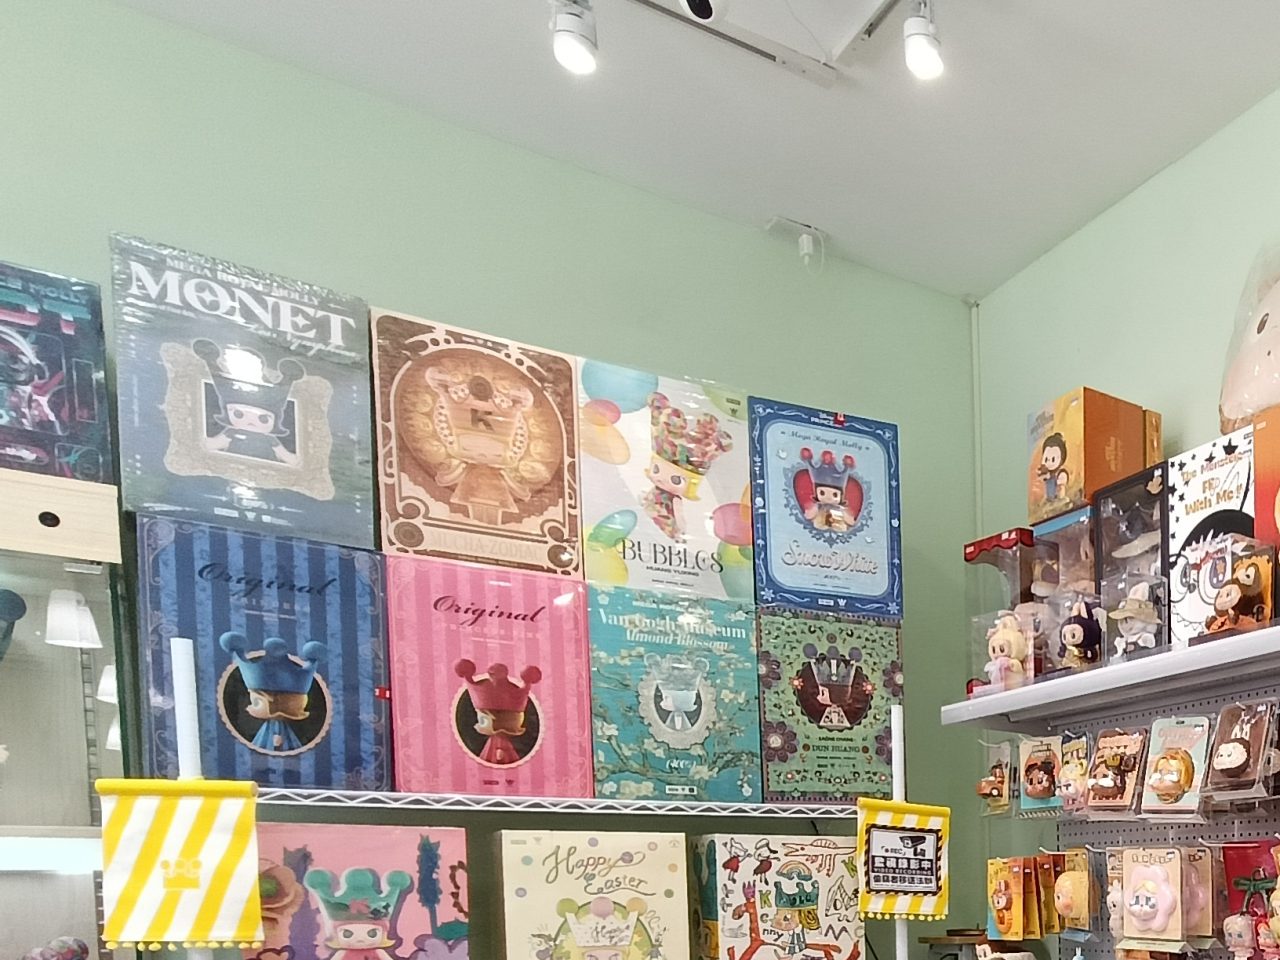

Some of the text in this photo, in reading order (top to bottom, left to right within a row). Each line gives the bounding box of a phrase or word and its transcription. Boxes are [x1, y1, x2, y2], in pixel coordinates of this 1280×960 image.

[127, 260, 357, 347] MONET
[198, 562, 338, 598] Original
[433, 595, 546, 626] Original
[542, 845, 646, 884] Happy
[895, 868, 932, 876] RECORDING
[584, 874, 657, 897] Easter
